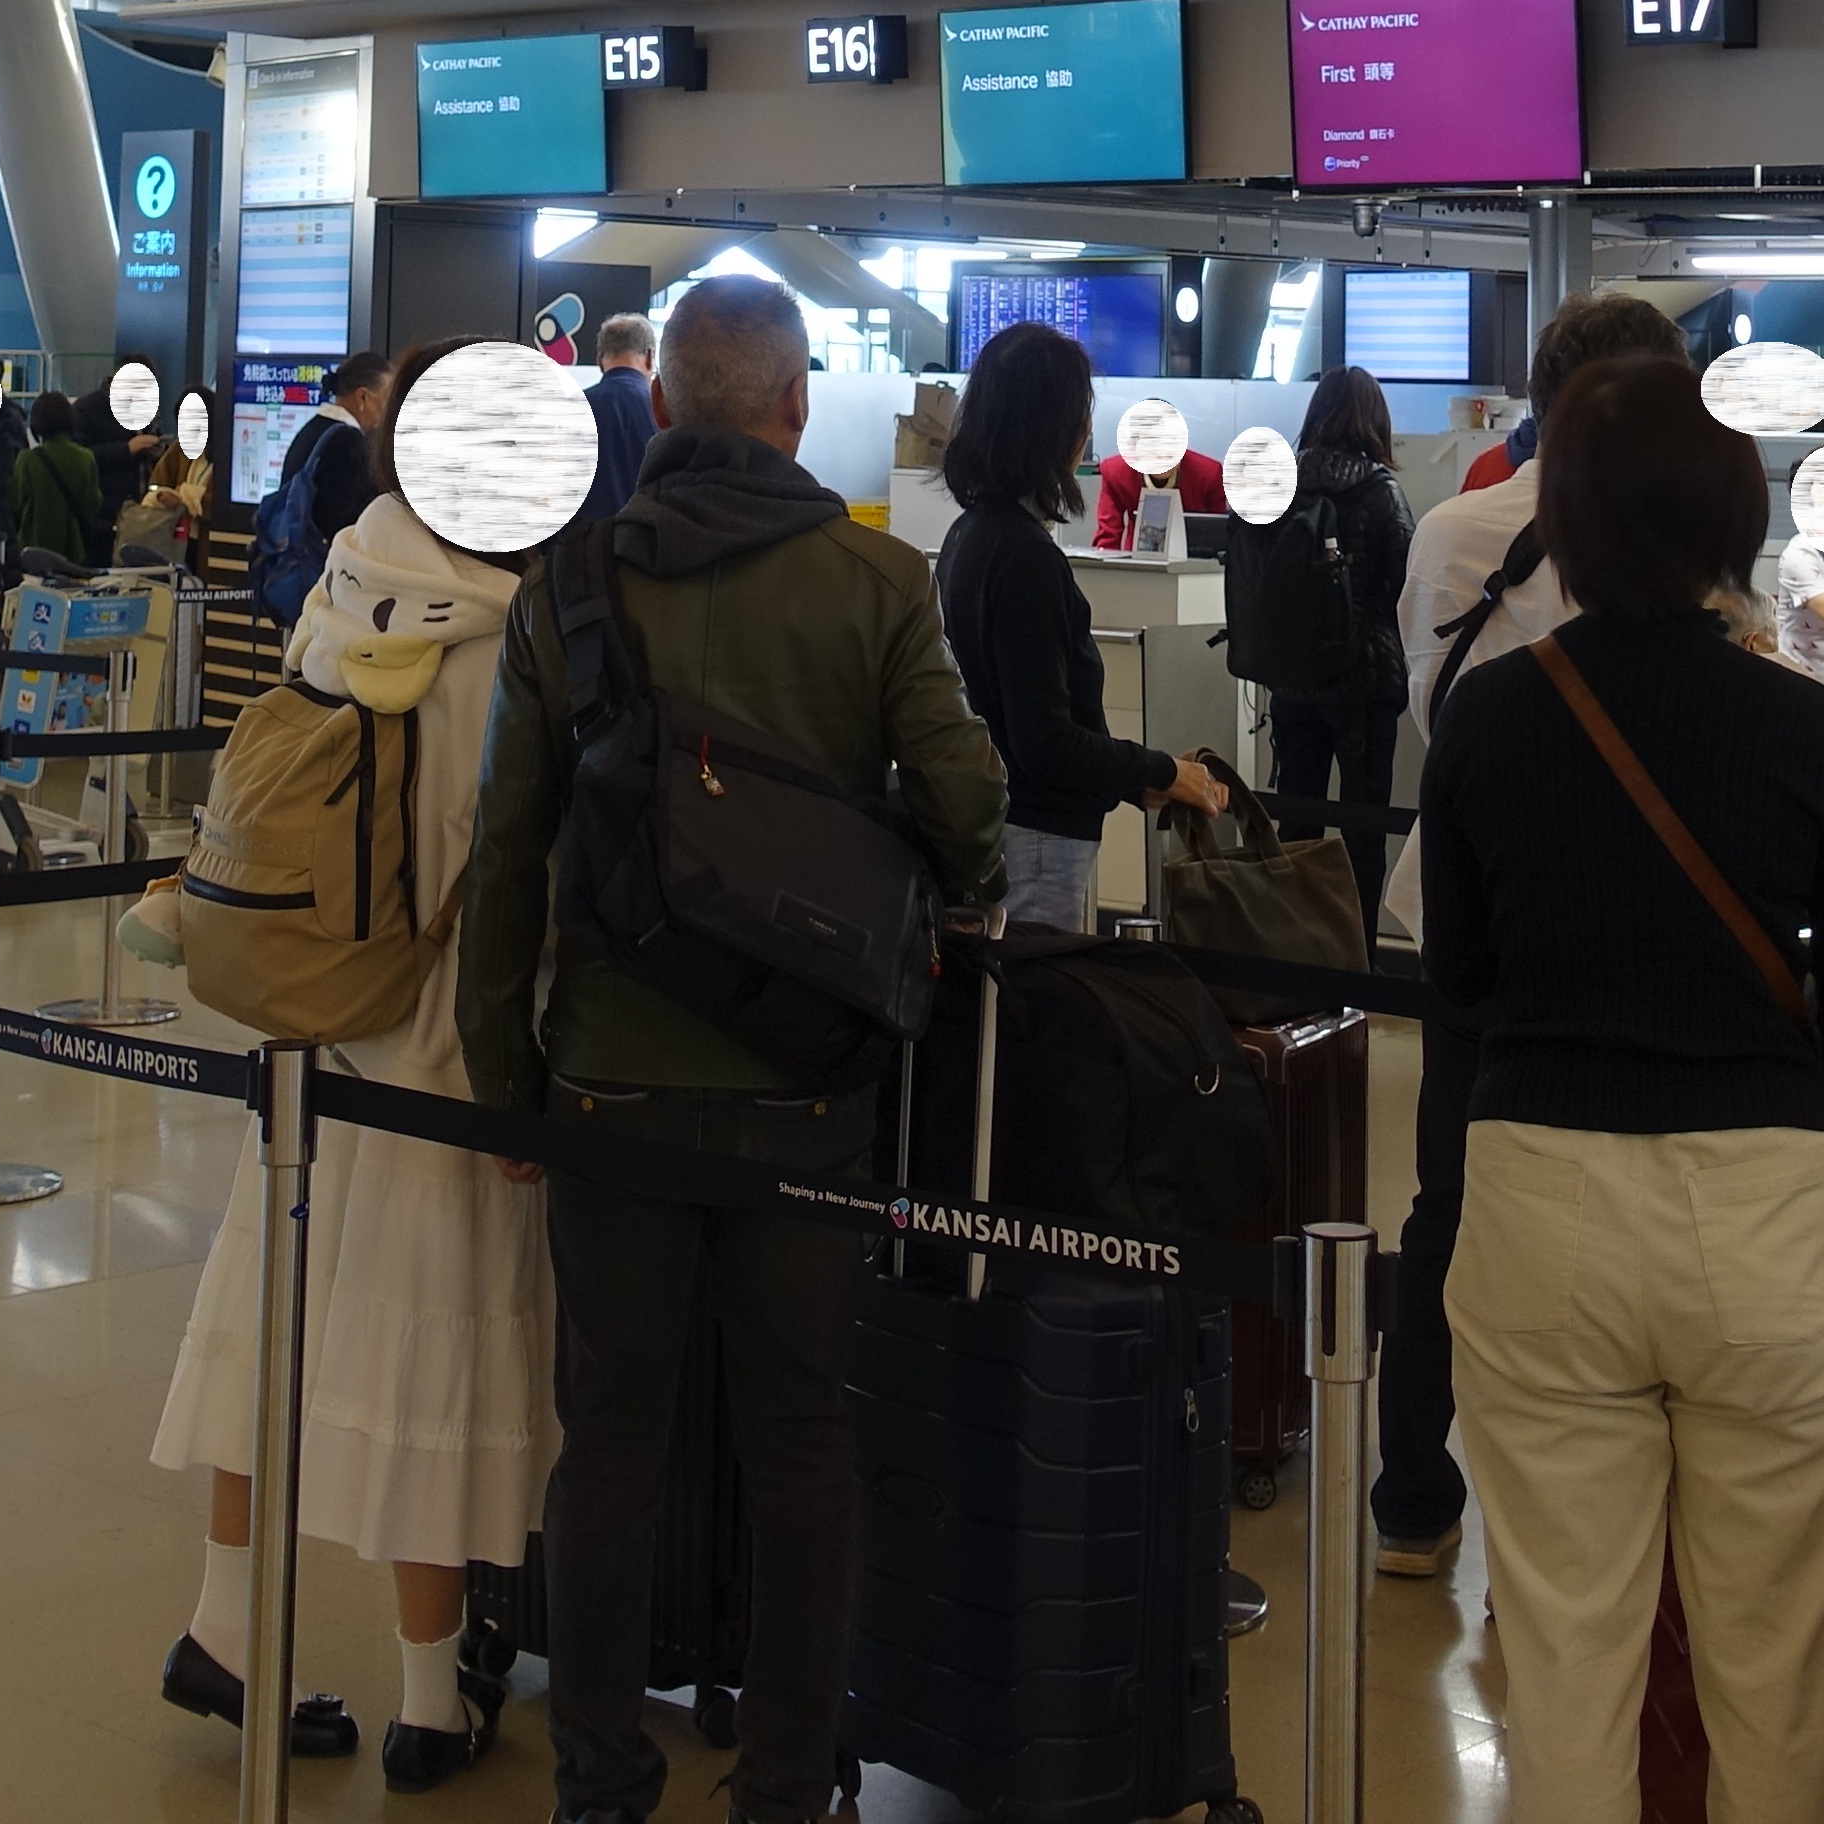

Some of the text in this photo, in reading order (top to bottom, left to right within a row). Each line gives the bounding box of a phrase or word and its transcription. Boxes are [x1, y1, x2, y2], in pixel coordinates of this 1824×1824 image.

[1318, 13, 1419, 31] CATHAY PACIFIC
[959, 24, 1049, 42] CATHAY PACIFIC
[604, 35, 661, 81] E15
[807, 25, 869, 74] E16
[432, 56, 502, 71] CATHAY PACIFIC
[1321, 62, 1395, 83] First 頭等
[961, 69, 1073, 92] Assistance 協助
[433, 97, 494, 116] Assistance
[1323, 129, 1365, 142] Diamond
[1336, 158, 1360, 170] Priority
[132, 230, 176, 255] ご案内
[53, 1032, 113, 1067] KANSAI
[115, 1045, 199, 1083] AIRPORTS
[779, 1181, 1181, 1275] Shaping a New Journey KANSAI AIRPORTS
